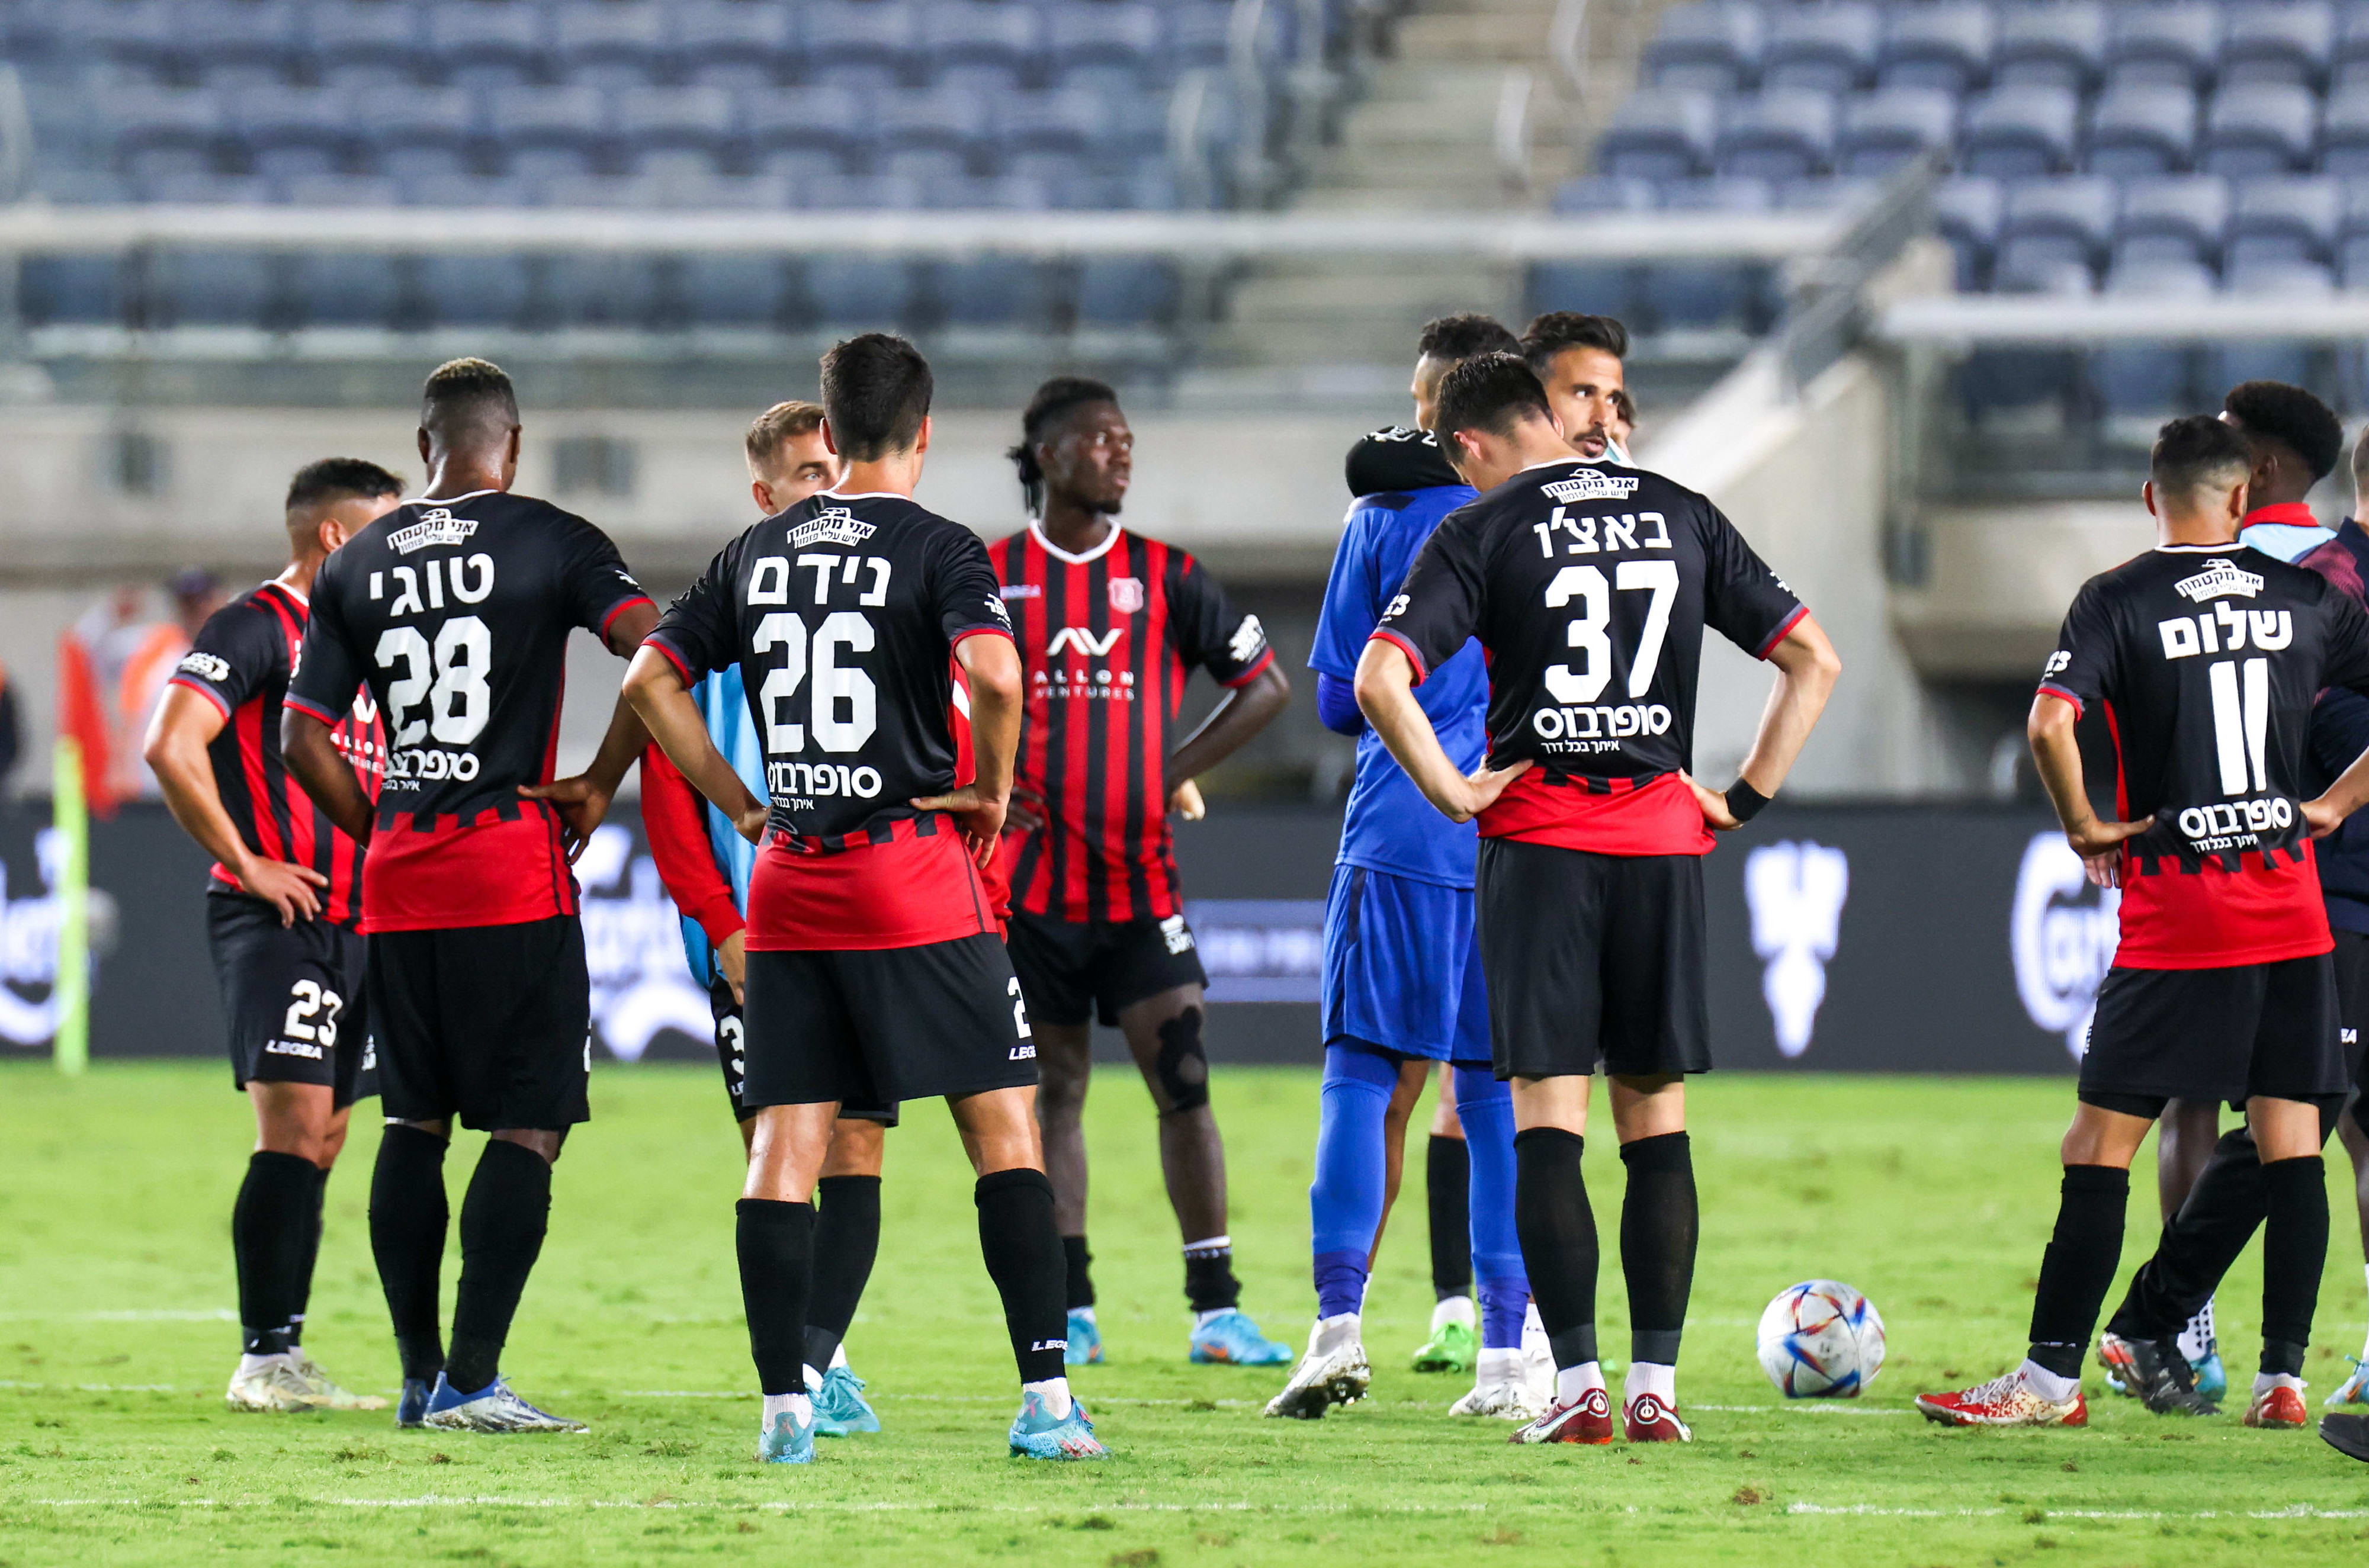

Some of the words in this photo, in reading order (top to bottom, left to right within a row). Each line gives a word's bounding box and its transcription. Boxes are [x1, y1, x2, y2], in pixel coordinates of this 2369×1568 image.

[1545, 480, 1604, 497] מקטמון
[1611, 479, 1635, 489] אני
[390, 520, 445, 546] מקטמון
[451, 521, 474, 533] אני
[788, 518, 844, 541] מקטמון
[849, 522, 872, 537] אני
[370, 552, 495, 617] טוגי
[747, 554, 892, 607] נידם
[2179, 571, 2235, 596] מקטמון
[2239, 573, 2260, 587] אני
[1545, 560, 1680, 703] 37
[2158, 600, 2293, 660] שלום
[374, 615, 492, 751] 28
[752, 612, 877, 754] 26
[1033, 669, 1135, 686] ALLON
[1533, 704, 1672, 740] סופרבוס
[2210, 658, 2269, 796] 11
[1540, 742, 1564, 754] דרך
[1564, 739, 1590, 753] בכל
[1590, 740, 1620, 754] איתך
[790, 798, 815, 812] איתך
[284, 979, 344, 1048] 23
